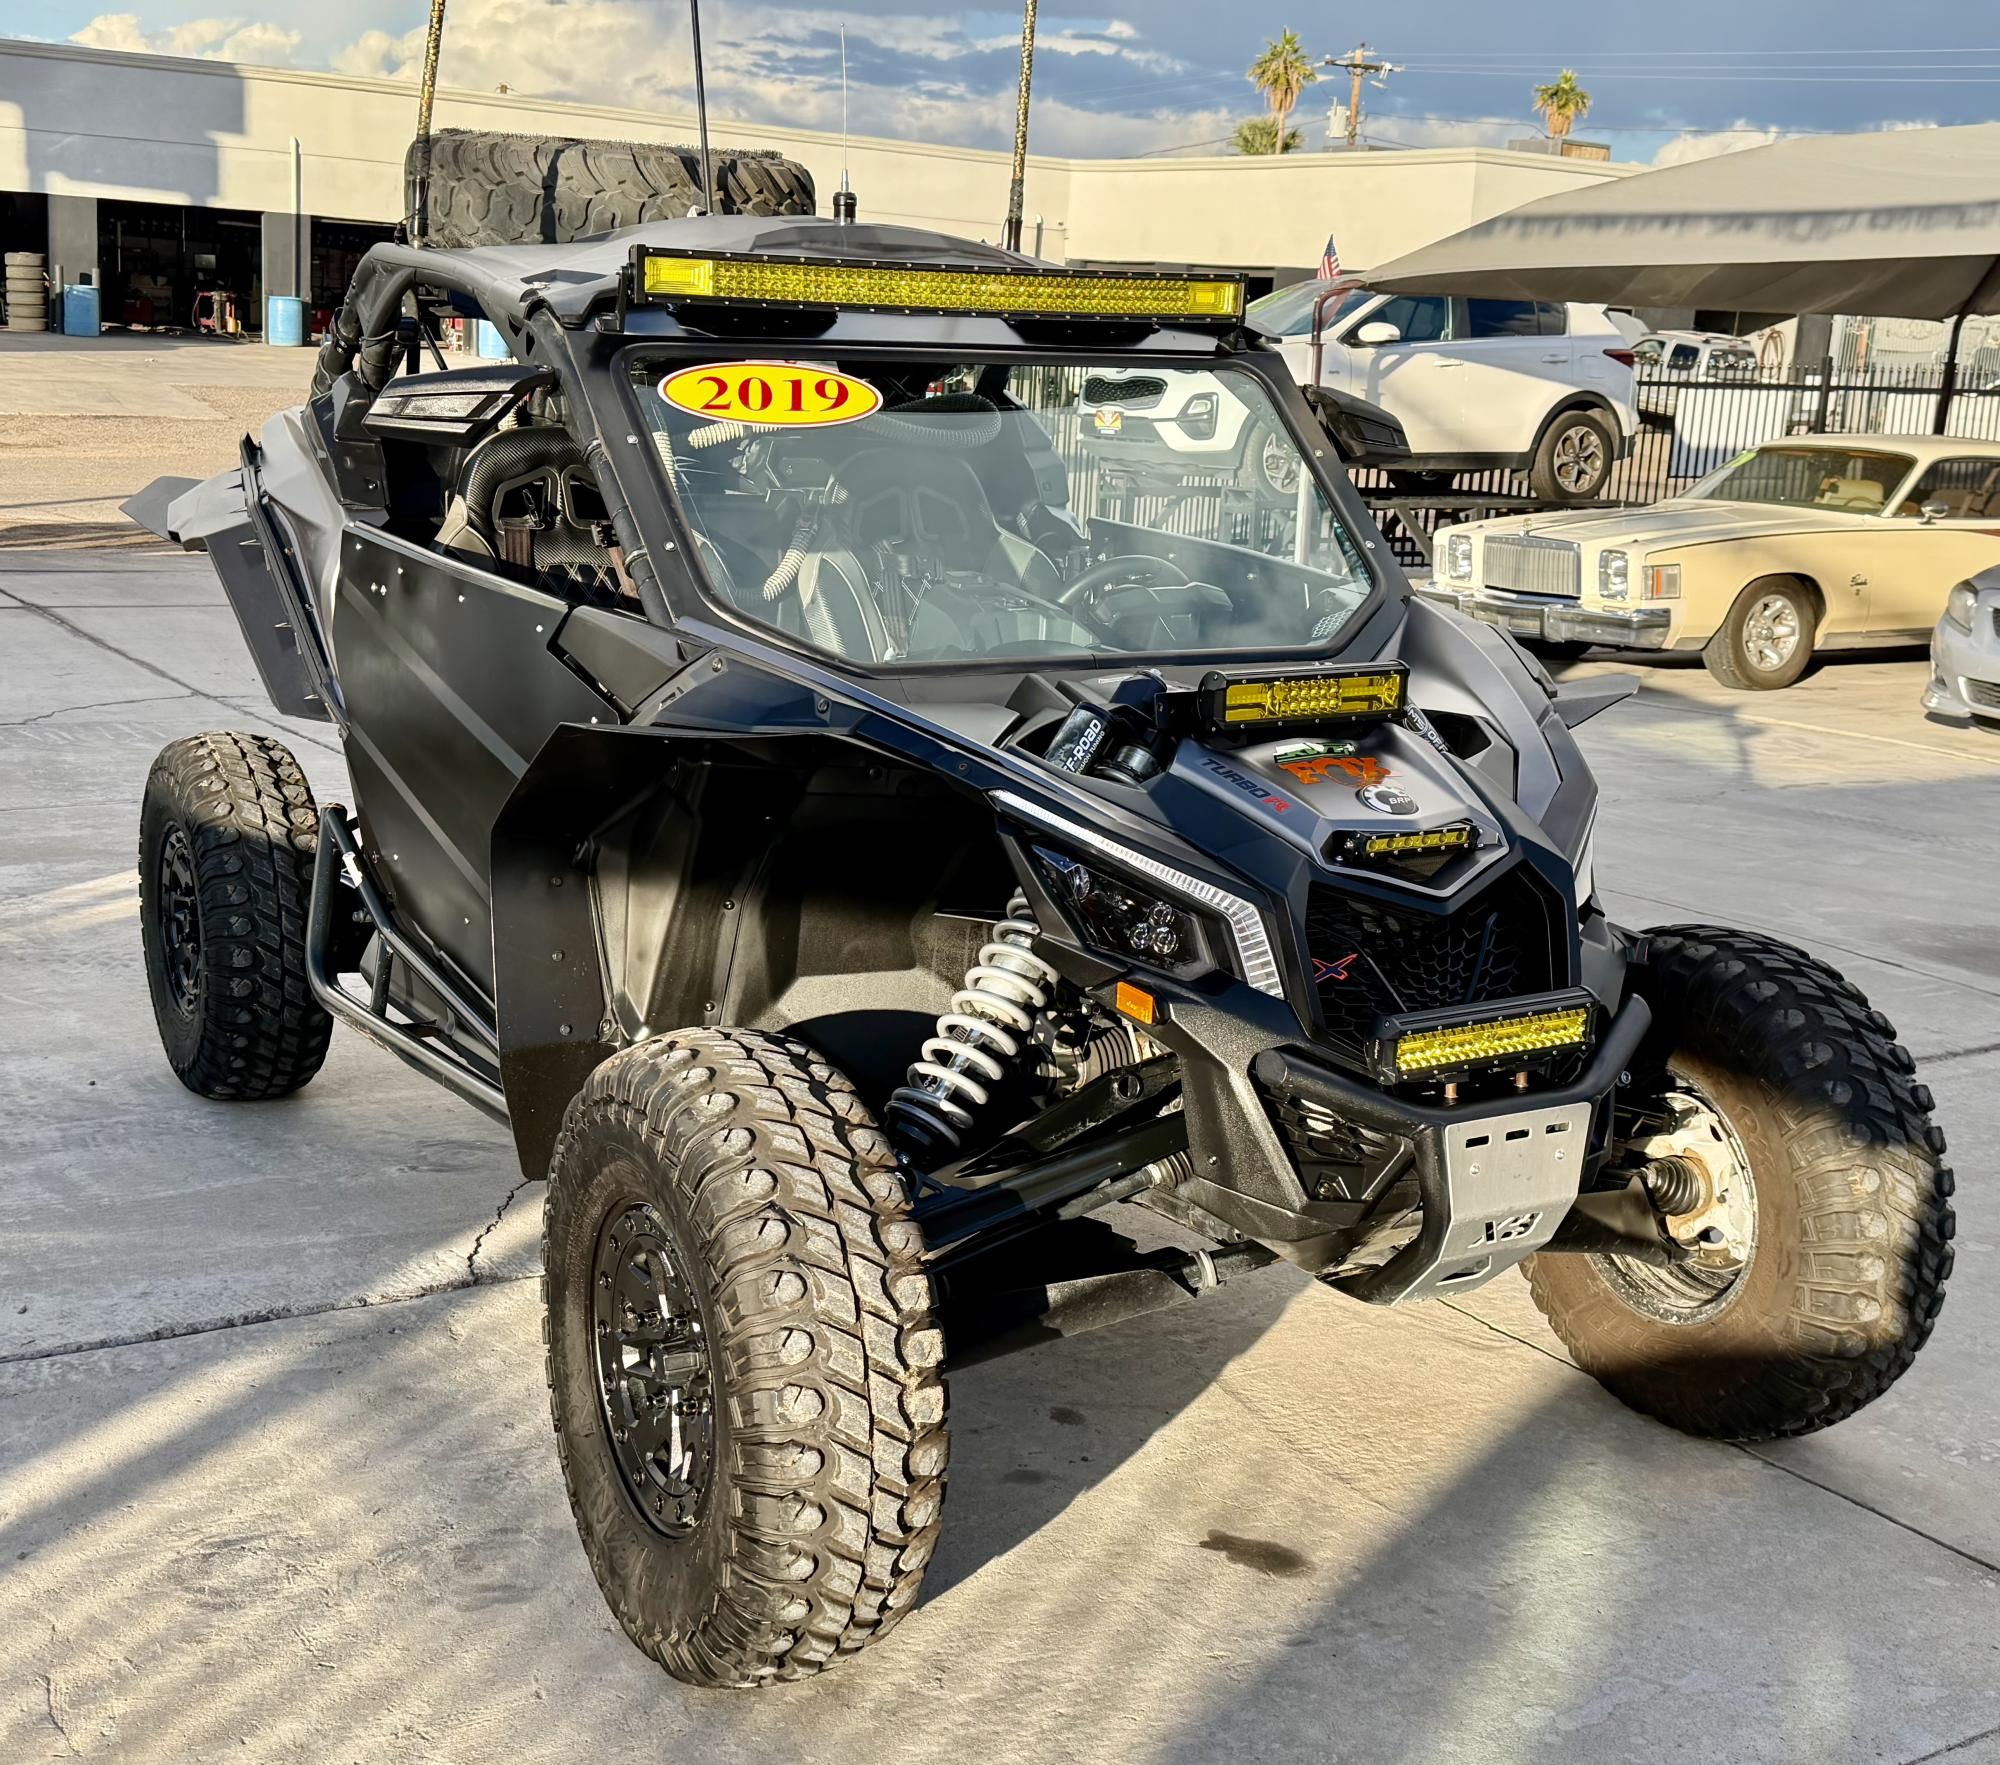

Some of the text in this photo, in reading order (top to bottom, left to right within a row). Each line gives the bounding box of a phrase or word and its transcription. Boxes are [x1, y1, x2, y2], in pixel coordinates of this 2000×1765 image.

[697, 376, 850, 412] 2019
[1200, 758, 1272, 800] TURBO
[1279, 756, 1393, 788] FOX
[1388, 797, 1411, 806] BRP
